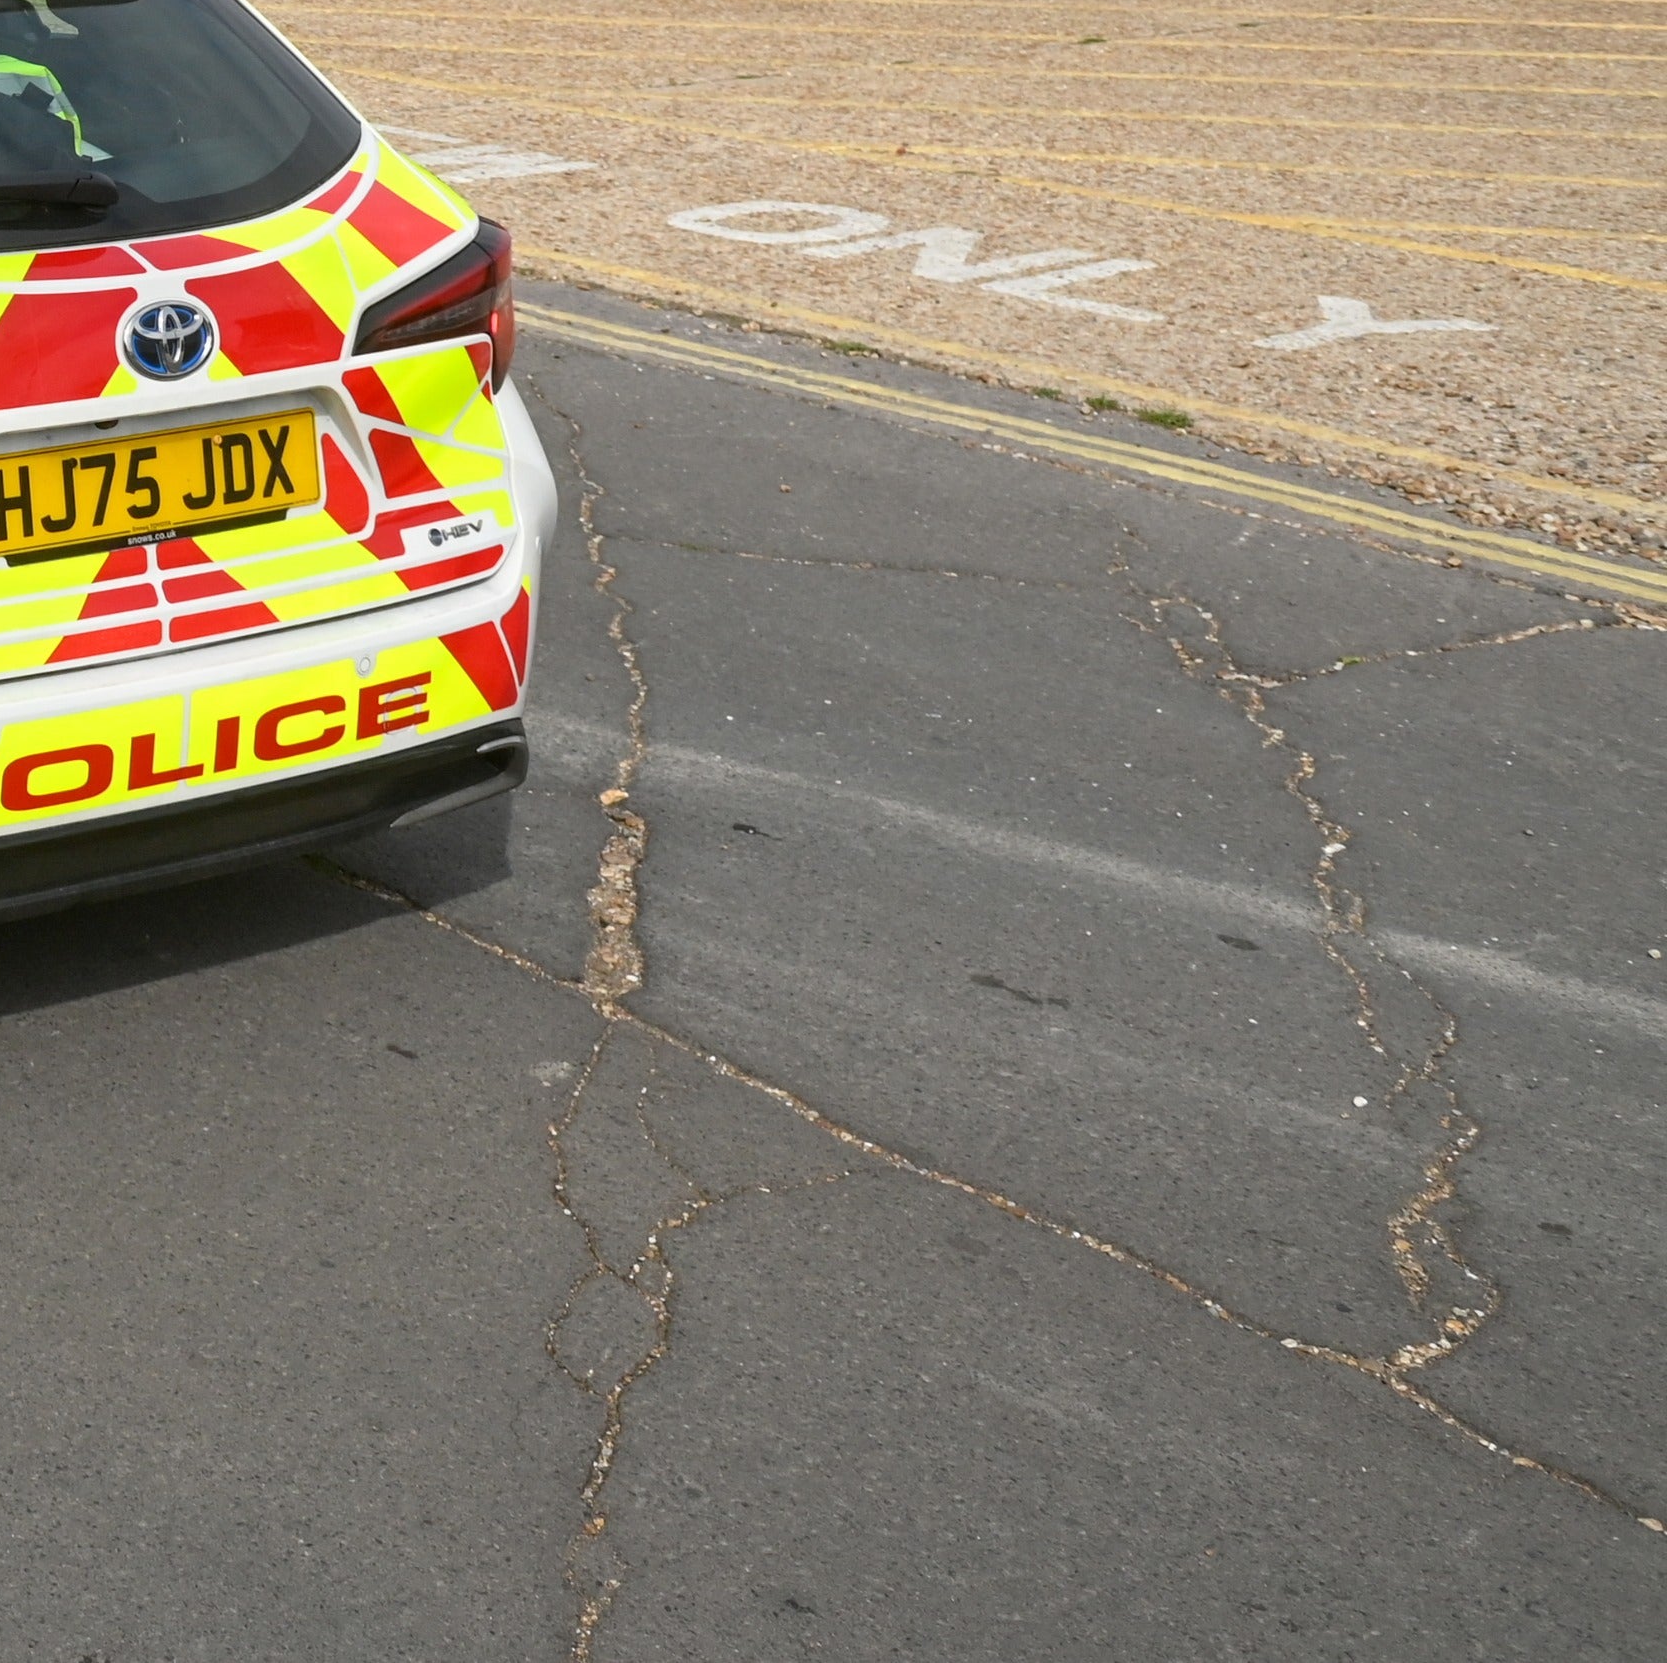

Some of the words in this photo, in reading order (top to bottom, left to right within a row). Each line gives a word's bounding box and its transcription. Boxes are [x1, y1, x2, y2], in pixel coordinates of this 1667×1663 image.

[182, 424, 296, 511] JDX
[127, 529, 177, 546] snows.co.uk
[441, 519, 483, 542] HEV
